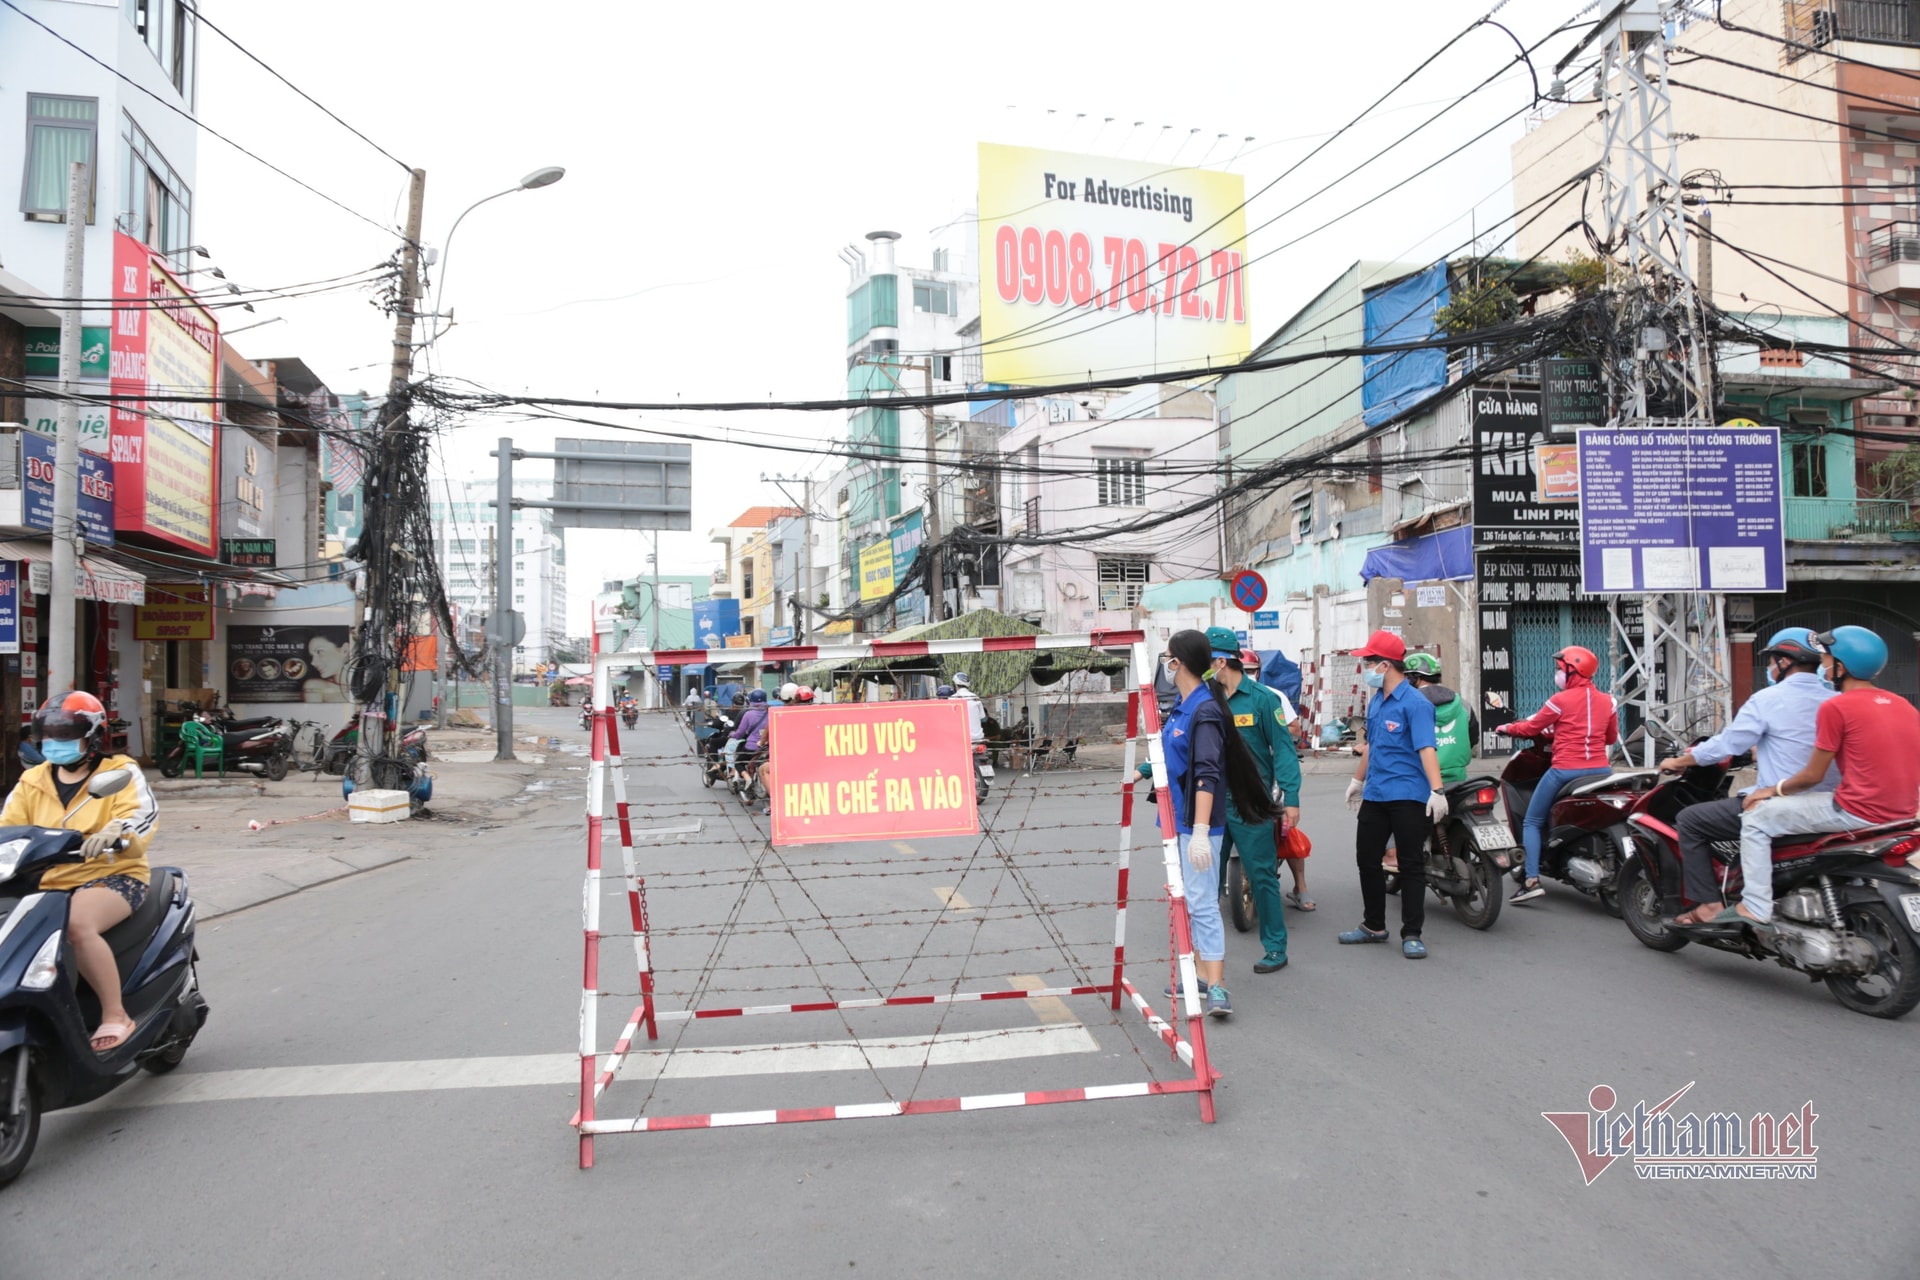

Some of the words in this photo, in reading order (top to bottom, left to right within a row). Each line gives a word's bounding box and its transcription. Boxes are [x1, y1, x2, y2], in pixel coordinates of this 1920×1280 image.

[1044, 172, 1076, 201] For
[1084, 177, 1193, 223] Advertising
[123, 266, 138, 294] XE
[995, 224, 1245, 324] 0908.70.72.71
[118, 302, 141, 336] MÁY
[110, 345, 146, 380] HOÀNG
[1552, 364, 1592, 375] HOTEL
[1549, 376, 1573, 393] THỦY
[1574, 377, 1598, 393] TRÚC
[1478, 396, 1502, 415] CỬA
[1506, 399, 1538, 416] HÀNG
[111, 434, 142, 463] SPACY
[1586, 432, 1611, 446] BẢNG
[1613, 433, 1638, 446] CÔNG
[1642, 432, 1654, 446] BỐ
[1656, 433, 1688, 446] THÔNG
[1690, 434, 1704, 446] TIN
[1706, 433, 1732, 446] CÔNG
[1734, 433, 1772, 446] TRƯỜNG
[81, 469, 113, 502] KẾT
[1492, 491, 1526, 502] MUA
[1513, 509, 1550, 520] LINH
[1483, 532, 1494, 540] 136
[243, 542, 260, 553] NAM
[263, 540, 274, 554] NỮ
[1484, 560, 1498, 576] ÉP
[1500, 560, 1524, 576] KÍNH
[1532, 564, 1558, 576] THAY
[1482, 582, 1509, 601] IPHONE
[1514, 582, 1530, 601] IPAD
[1536, 582, 1570, 601] SAMSUNG
[824, 724, 868, 757] KHU
[873, 718, 917, 761] VỰC
[784, 782, 830, 825] HẠN
[836, 768, 880, 815] CHẾ
[885, 778, 915, 812] RA
[918, 769, 963, 811] VÀO
